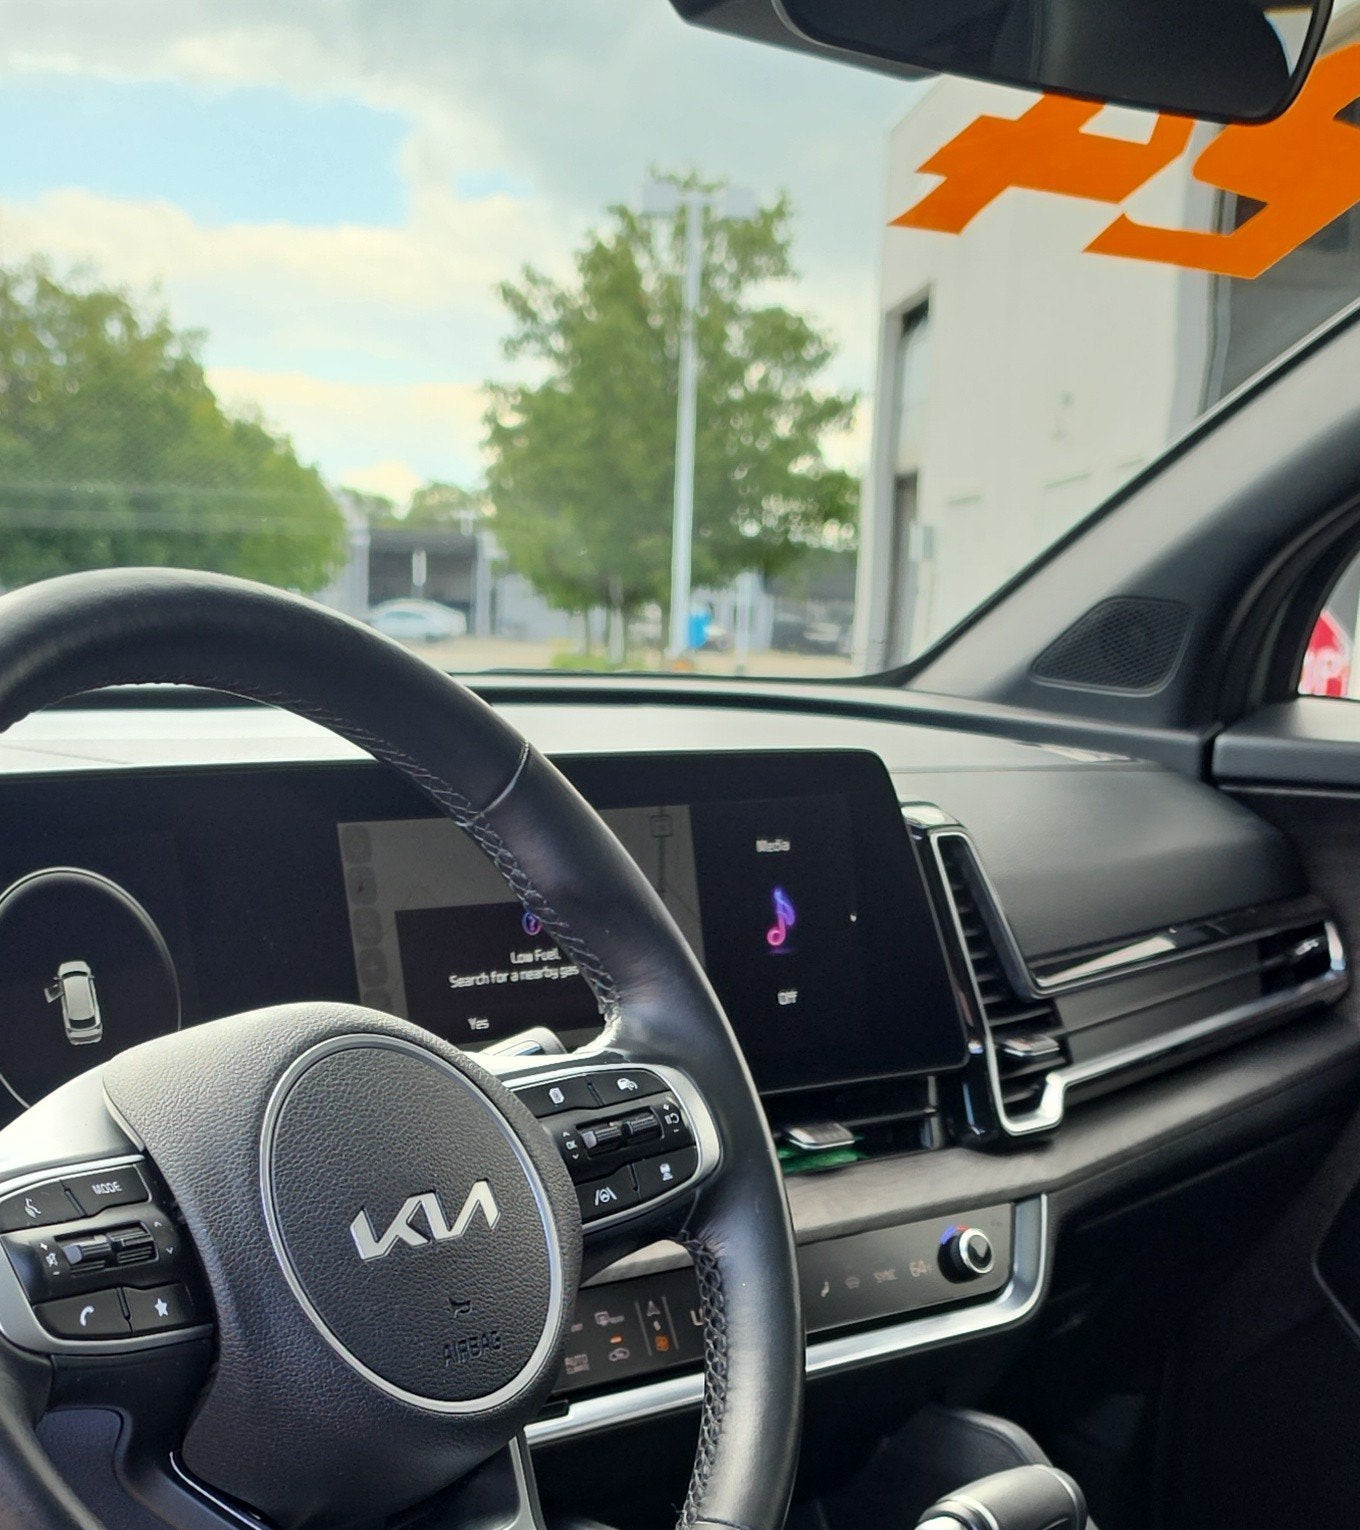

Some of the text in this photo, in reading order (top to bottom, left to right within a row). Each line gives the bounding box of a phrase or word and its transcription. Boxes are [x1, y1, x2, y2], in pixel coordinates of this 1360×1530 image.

[448, 973, 490, 989] Search
[490, 970, 509, 983] for
[509, 972, 519, 982] a
[519, 965, 559, 980] nearby
[467, 1017, 490, 1030] Yes
[91, 1180, 123, 1196] MODE
[349, 1178, 502, 1262] KIA
[443, 1330, 501, 1367] AIRBAG
